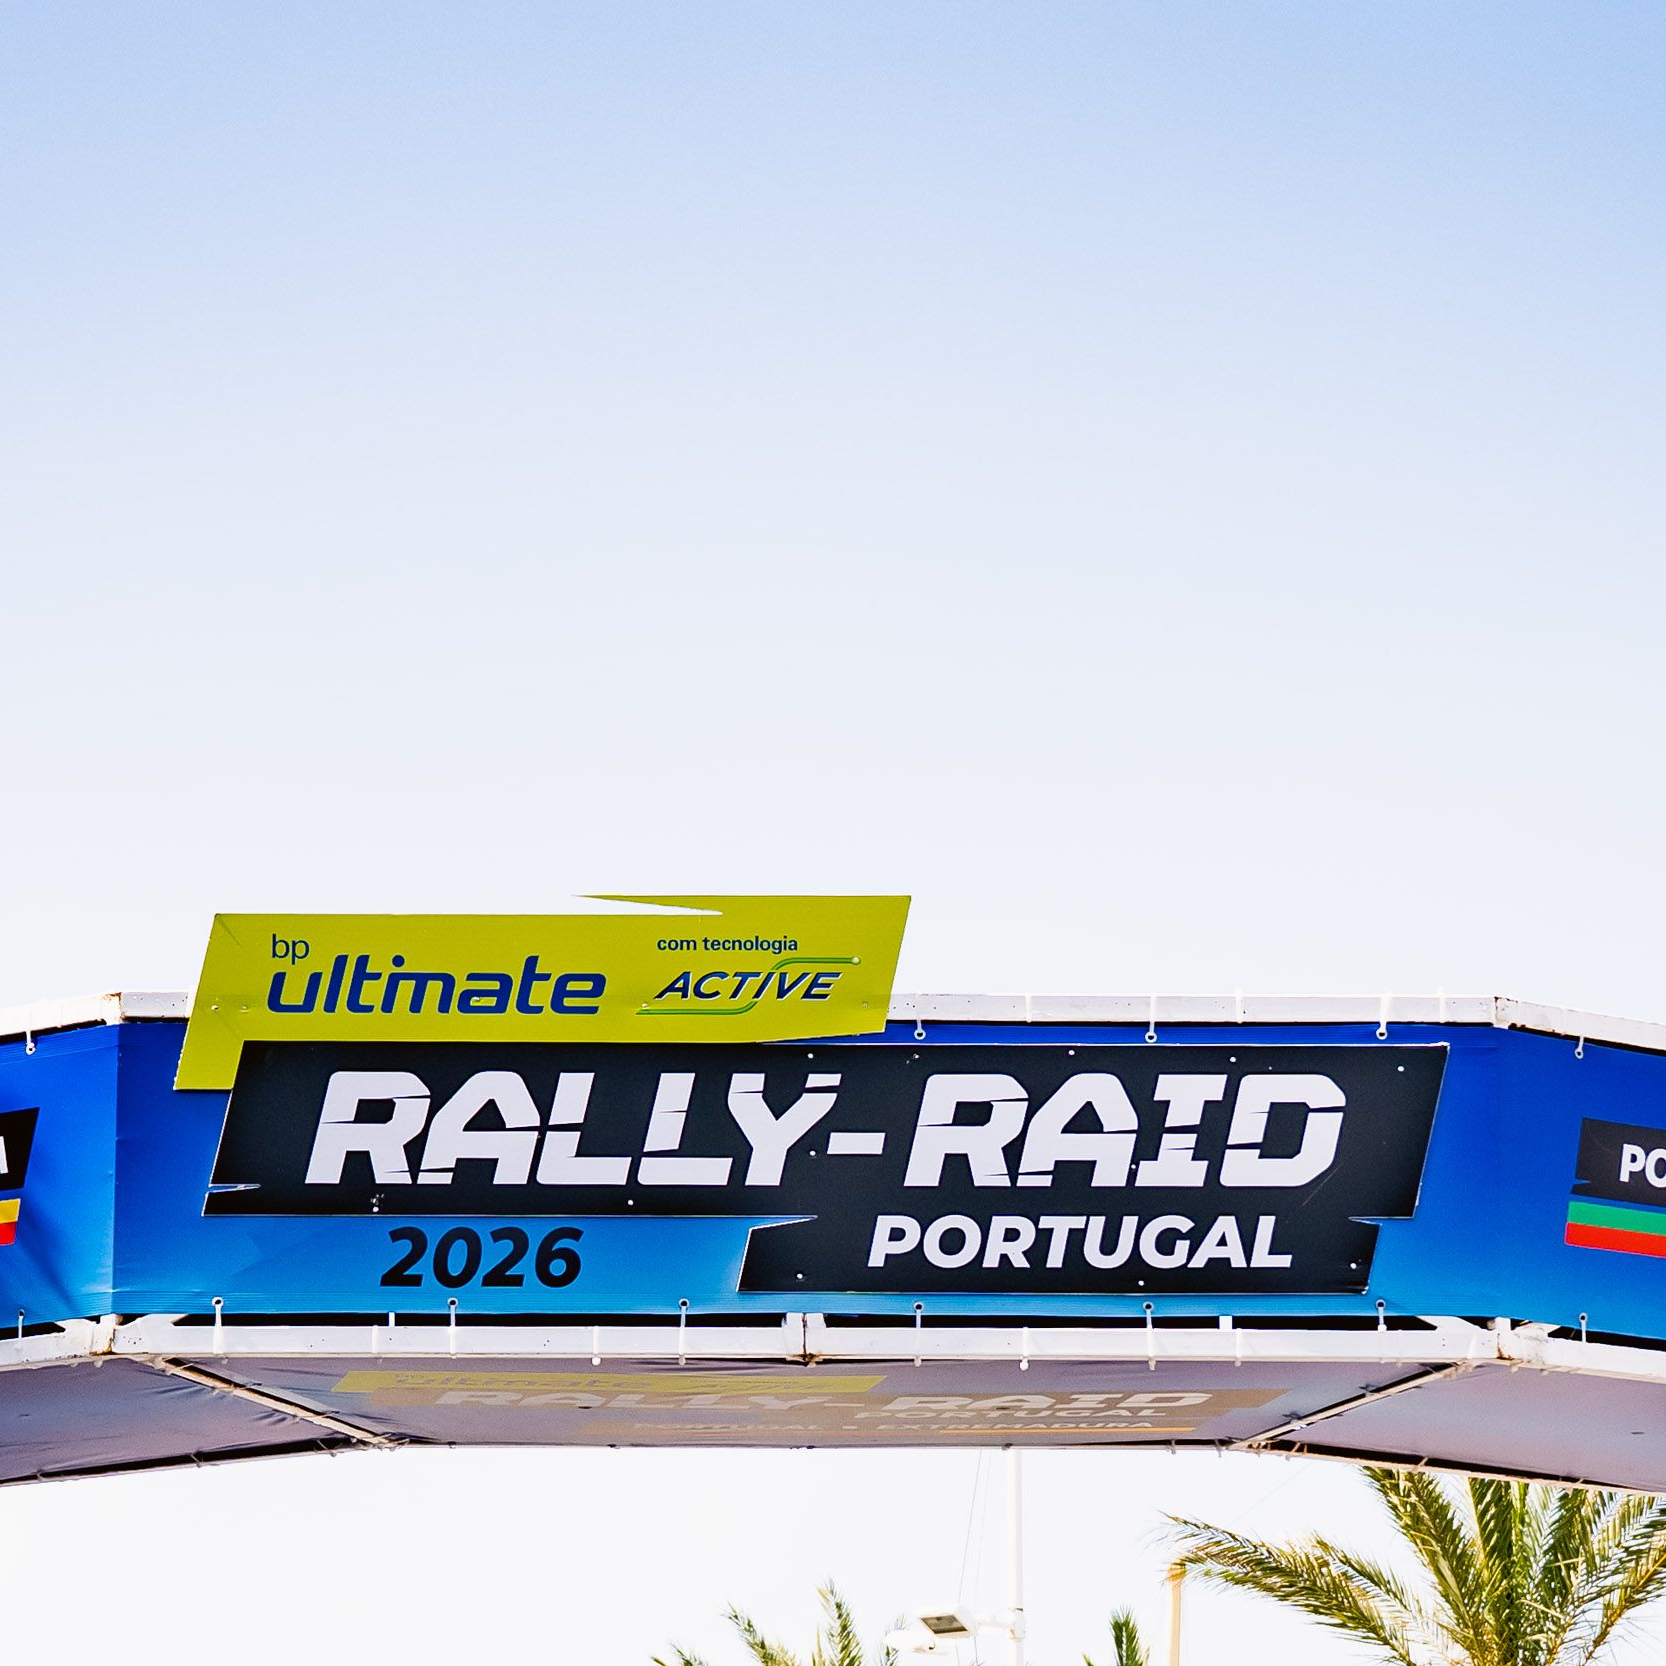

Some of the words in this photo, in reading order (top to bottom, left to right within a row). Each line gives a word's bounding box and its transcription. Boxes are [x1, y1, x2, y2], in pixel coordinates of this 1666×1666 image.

[271, 933, 311, 965] bp
[656, 938, 700, 952] com
[702, 935, 799, 956] tecnologia
[267, 954, 608, 1015] ultimate
[653, 970, 843, 1000] ACTIVE
[305, 1069, 1349, 1189] RALLY-RAID
[380, 1226, 584, 1290] 2026
[866, 1215, 1295, 1270] PORTUGAL
